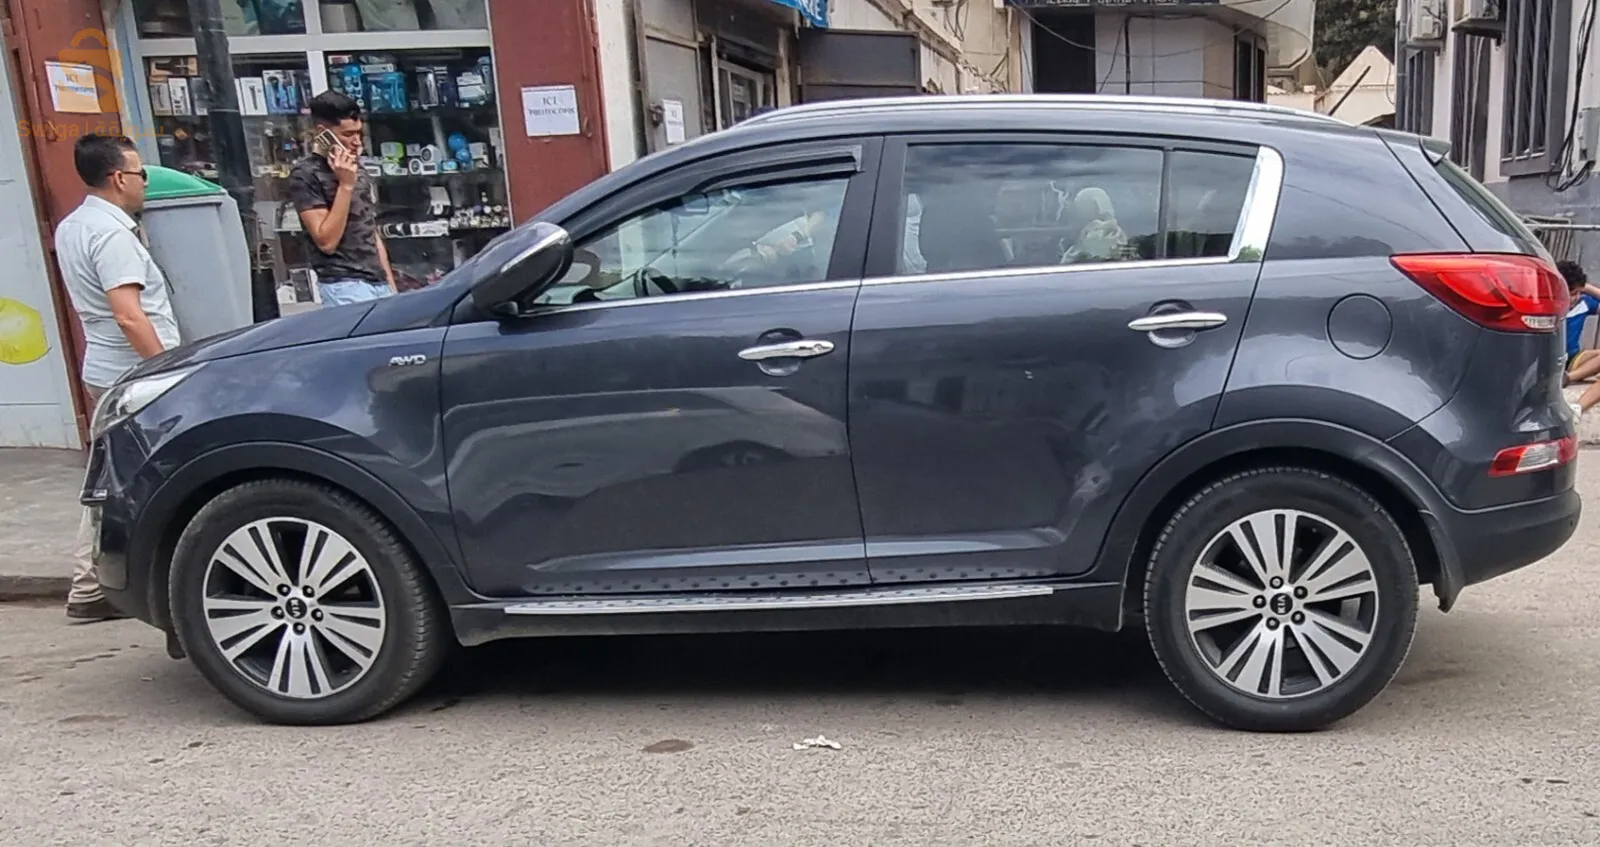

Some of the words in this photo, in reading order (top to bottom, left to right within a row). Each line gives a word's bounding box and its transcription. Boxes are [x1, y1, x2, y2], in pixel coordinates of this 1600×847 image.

[542, 95, 557, 105] ICI
[389, 354, 426, 366] AWD
[290, 599, 300, 617] KIA
[1277, 595, 1286, 614] KIA
